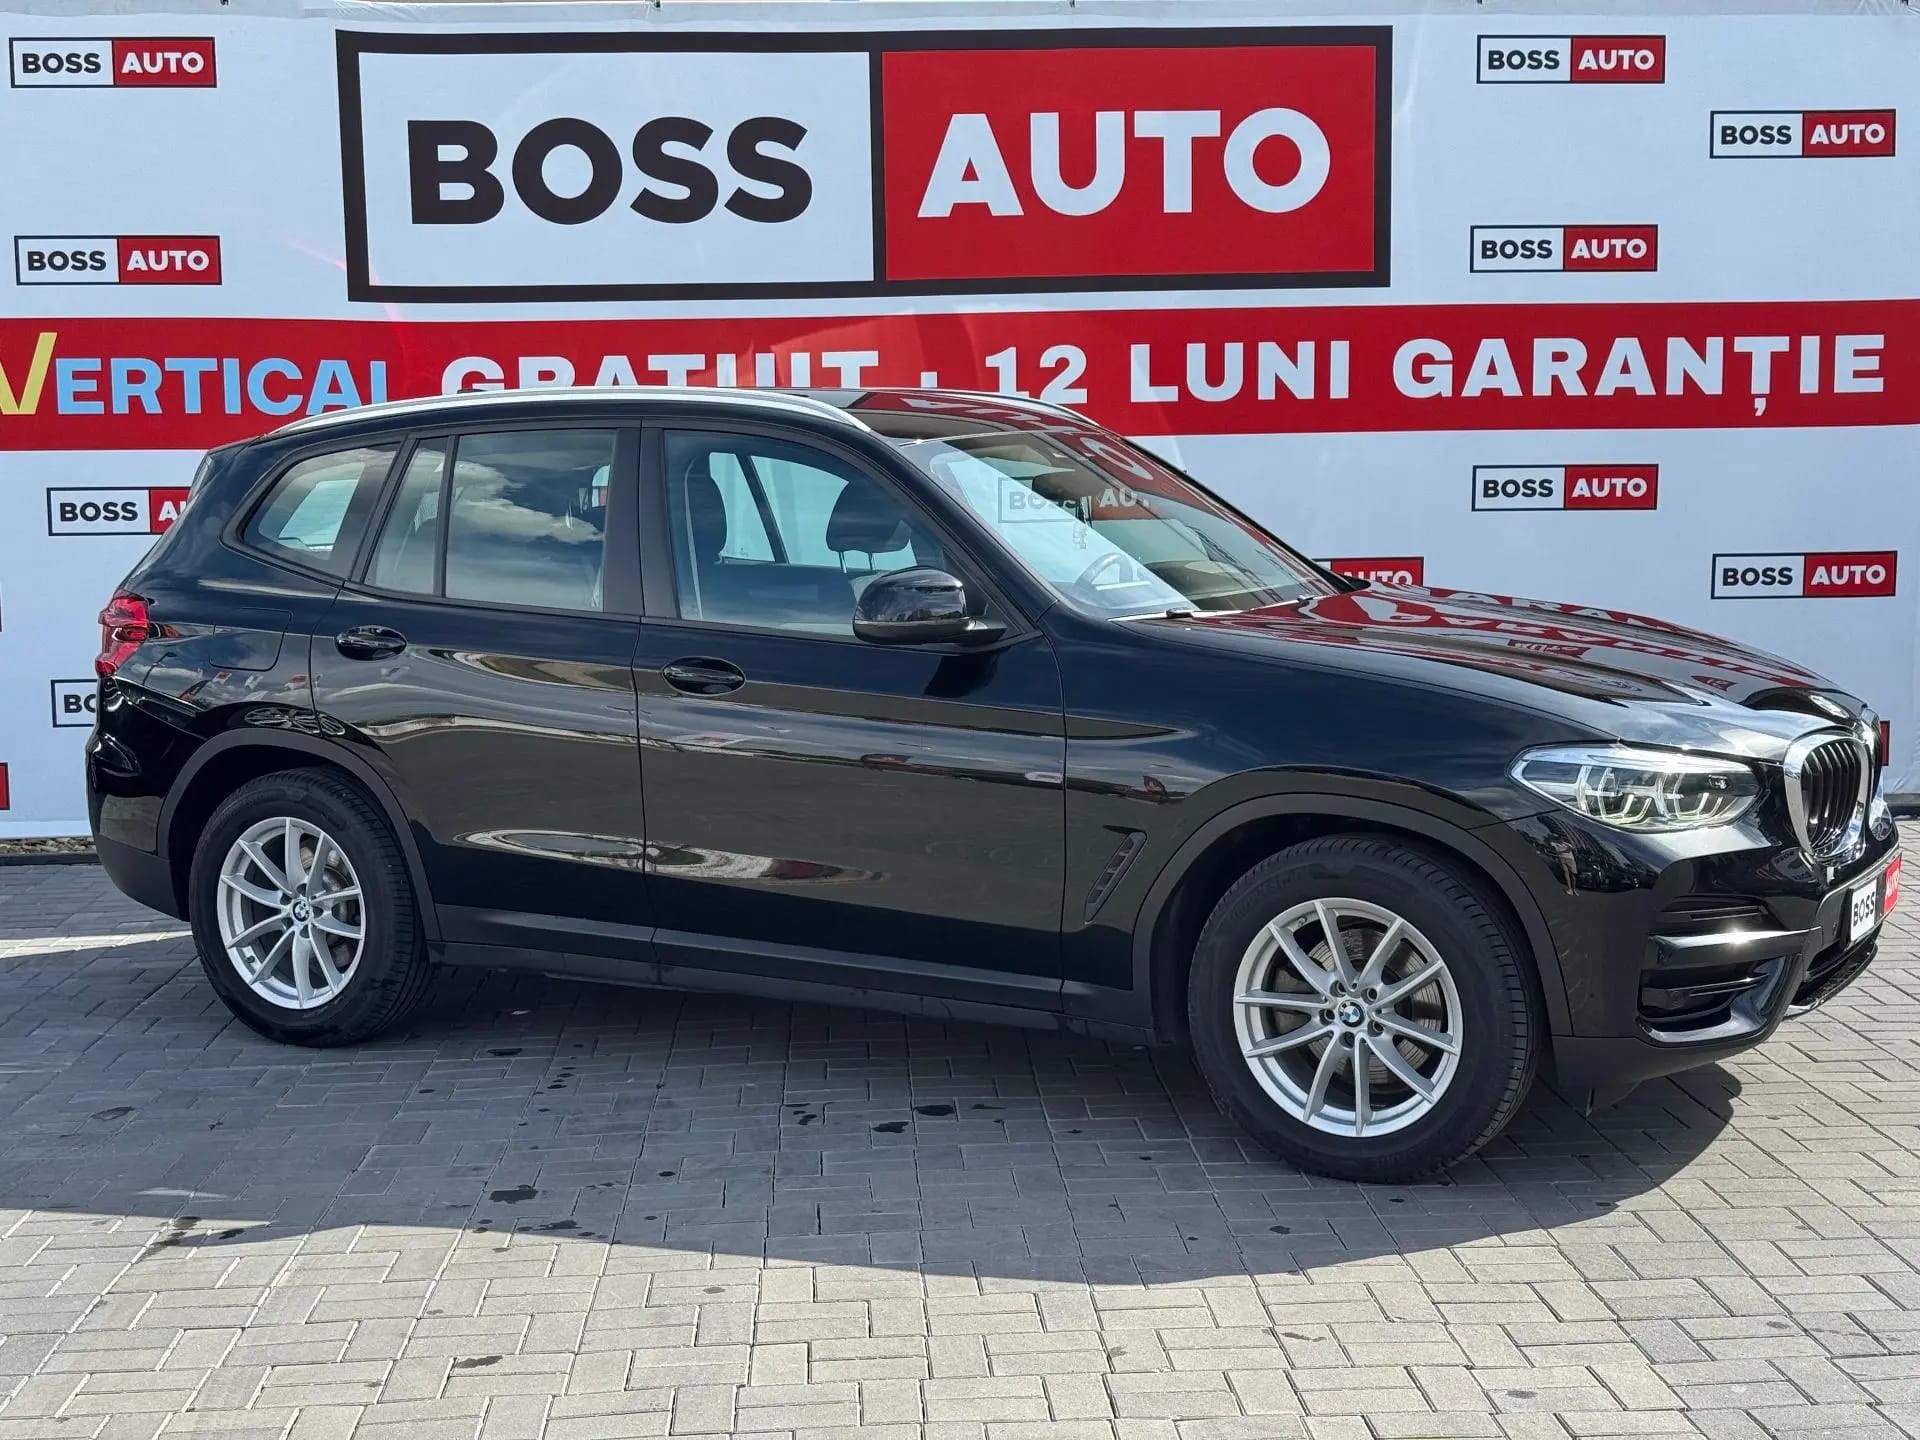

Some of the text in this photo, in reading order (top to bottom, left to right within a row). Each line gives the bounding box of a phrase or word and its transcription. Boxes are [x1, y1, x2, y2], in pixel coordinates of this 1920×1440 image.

[22, 52, 205, 74] BOSS AUTO
[1489, 49, 1655, 70] BOSS AUTO
[1721, 124, 1886, 145] BOSS AUTO
[408, 107, 1331, 225] BOSS AUTO
[1481, 238, 1647, 260] BOSS AUTO
[27, 250, 210, 271] BOSS AUTO
[985, 344, 1088, 404] 12
[1130, 340, 1350, 403] LUNI
[1392, 334, 1885, 417] GARANȚIE
[1482, 477, 1648, 498] BOSS AUTO
[59, 502, 138, 522] BOSS
[1722, 565, 1886, 586] BOSS AUTO
[1853, 891, 1875, 927] BOSS
